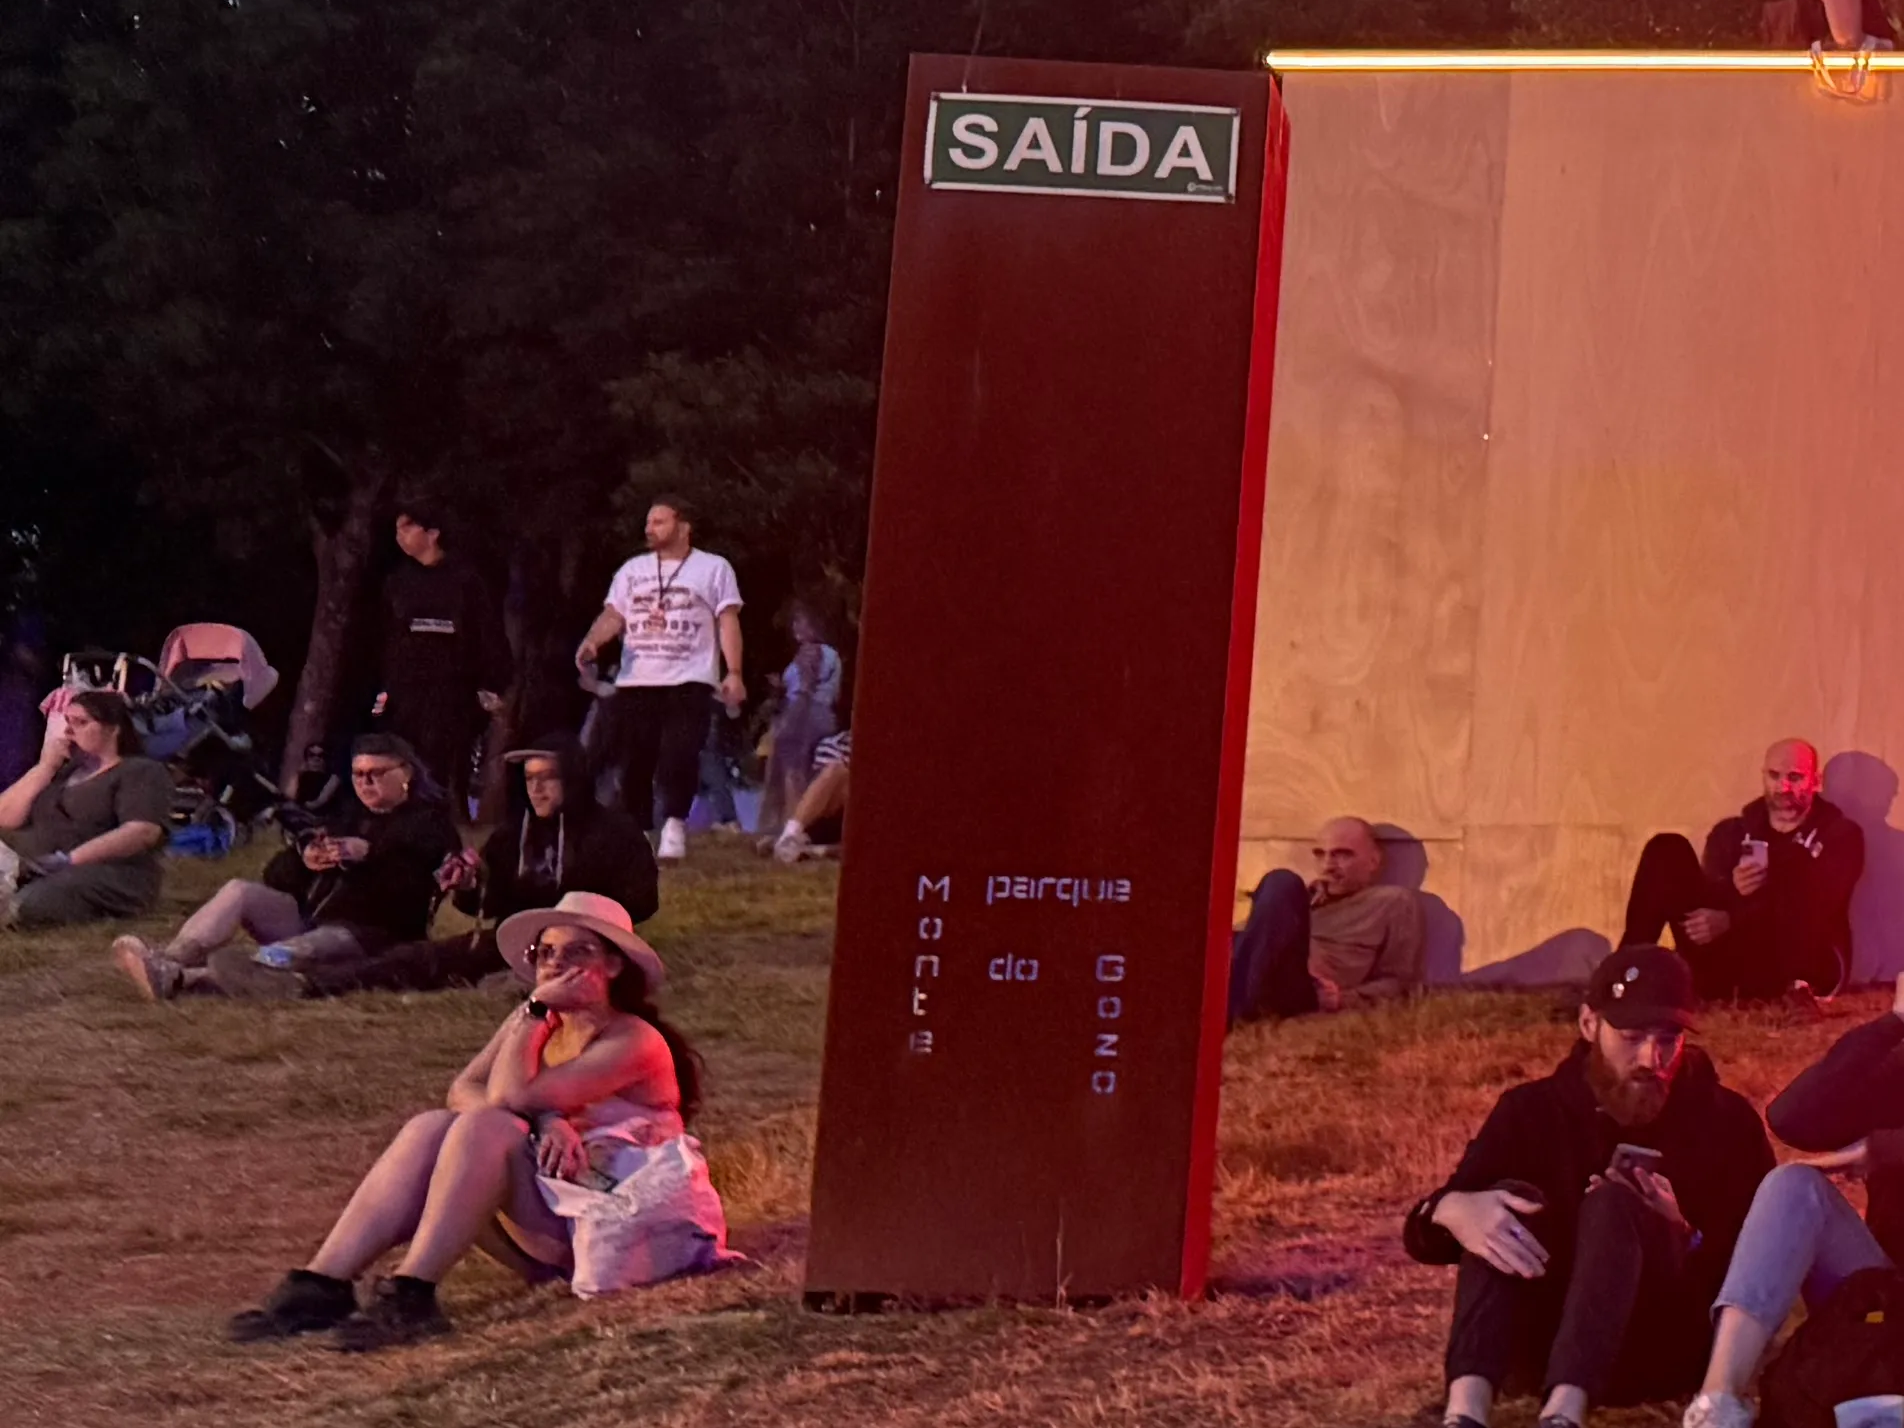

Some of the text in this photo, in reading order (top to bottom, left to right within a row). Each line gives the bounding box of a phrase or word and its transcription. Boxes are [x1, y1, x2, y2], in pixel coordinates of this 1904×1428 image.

[948, 107, 1214, 181] SAÍDA
[986, 875, 1132, 908] parque
[988, 952, 1040, 981] do
